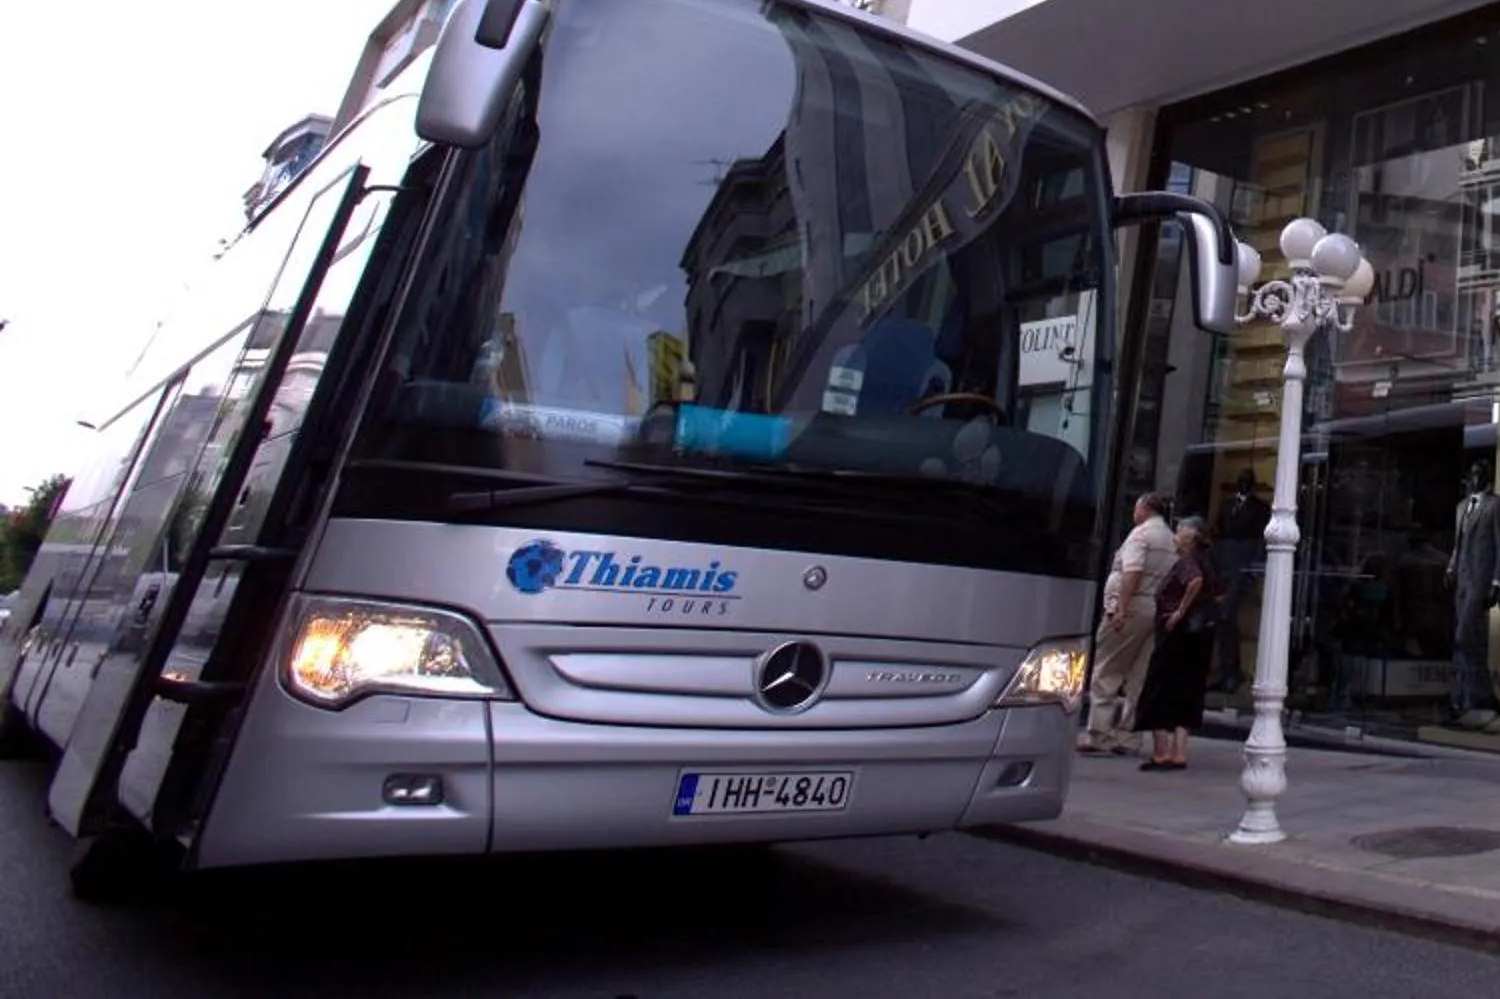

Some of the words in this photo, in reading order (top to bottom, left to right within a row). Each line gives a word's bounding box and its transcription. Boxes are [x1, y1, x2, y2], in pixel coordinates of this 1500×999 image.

[563, 550, 738, 593] Thiamis
[645, 597, 729, 616] TOURS
[707, 775, 847, 810] IHH-4840
